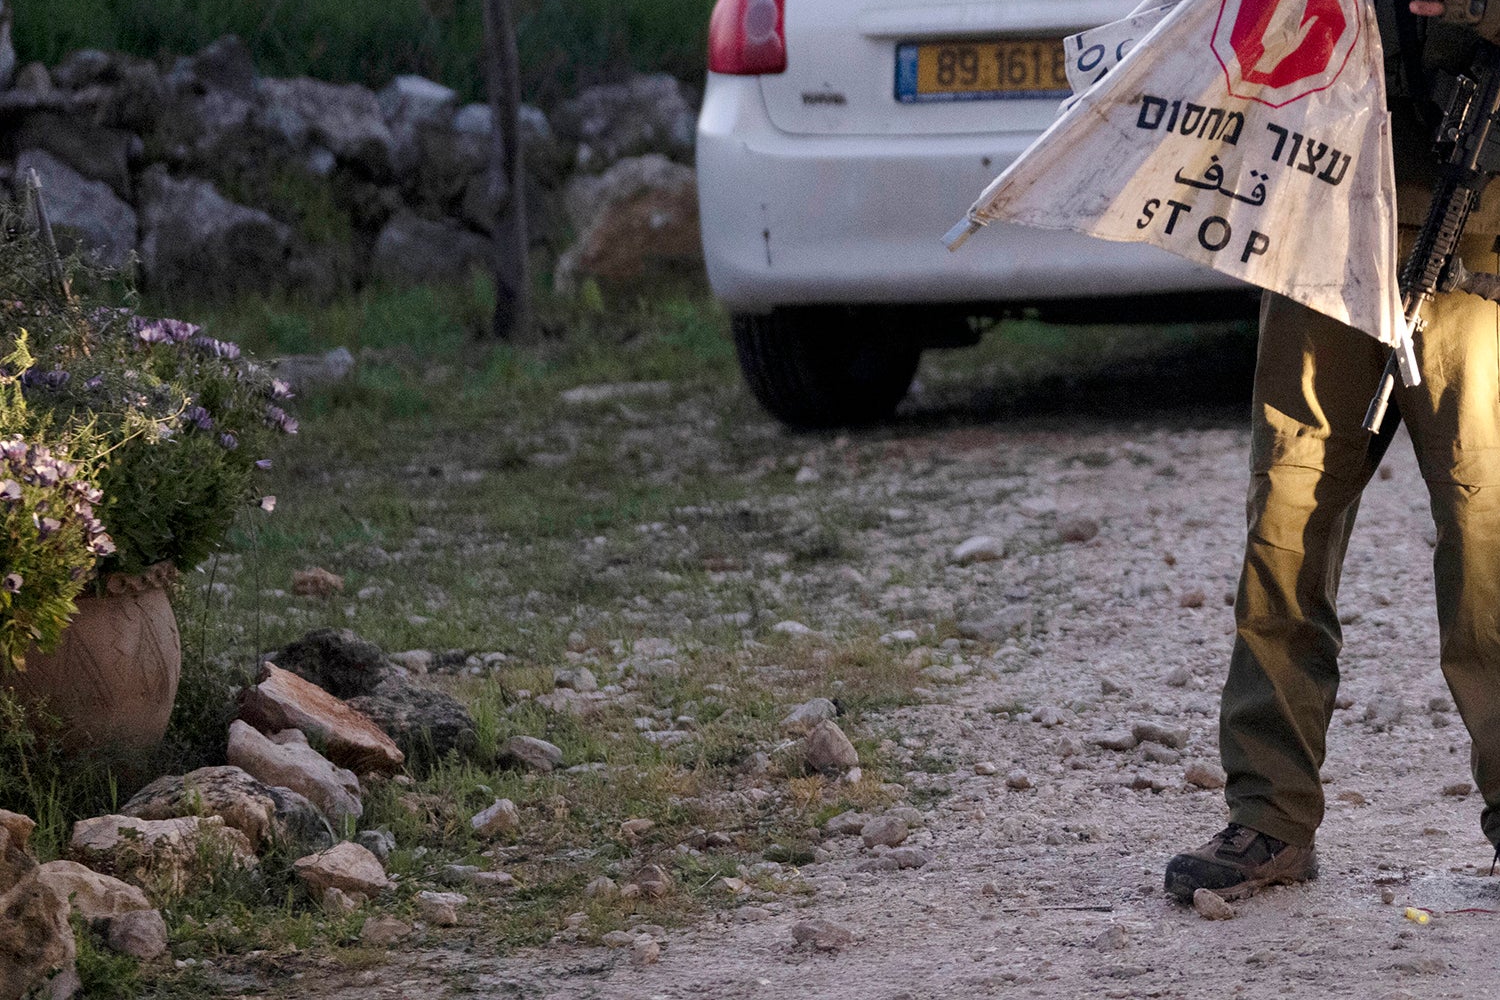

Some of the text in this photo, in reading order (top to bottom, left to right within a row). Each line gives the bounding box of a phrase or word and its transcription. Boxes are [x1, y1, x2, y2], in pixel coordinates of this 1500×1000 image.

[1135, 94, 1352, 187] עצור מחסום
[1136, 198, 1271, 264] STOP
